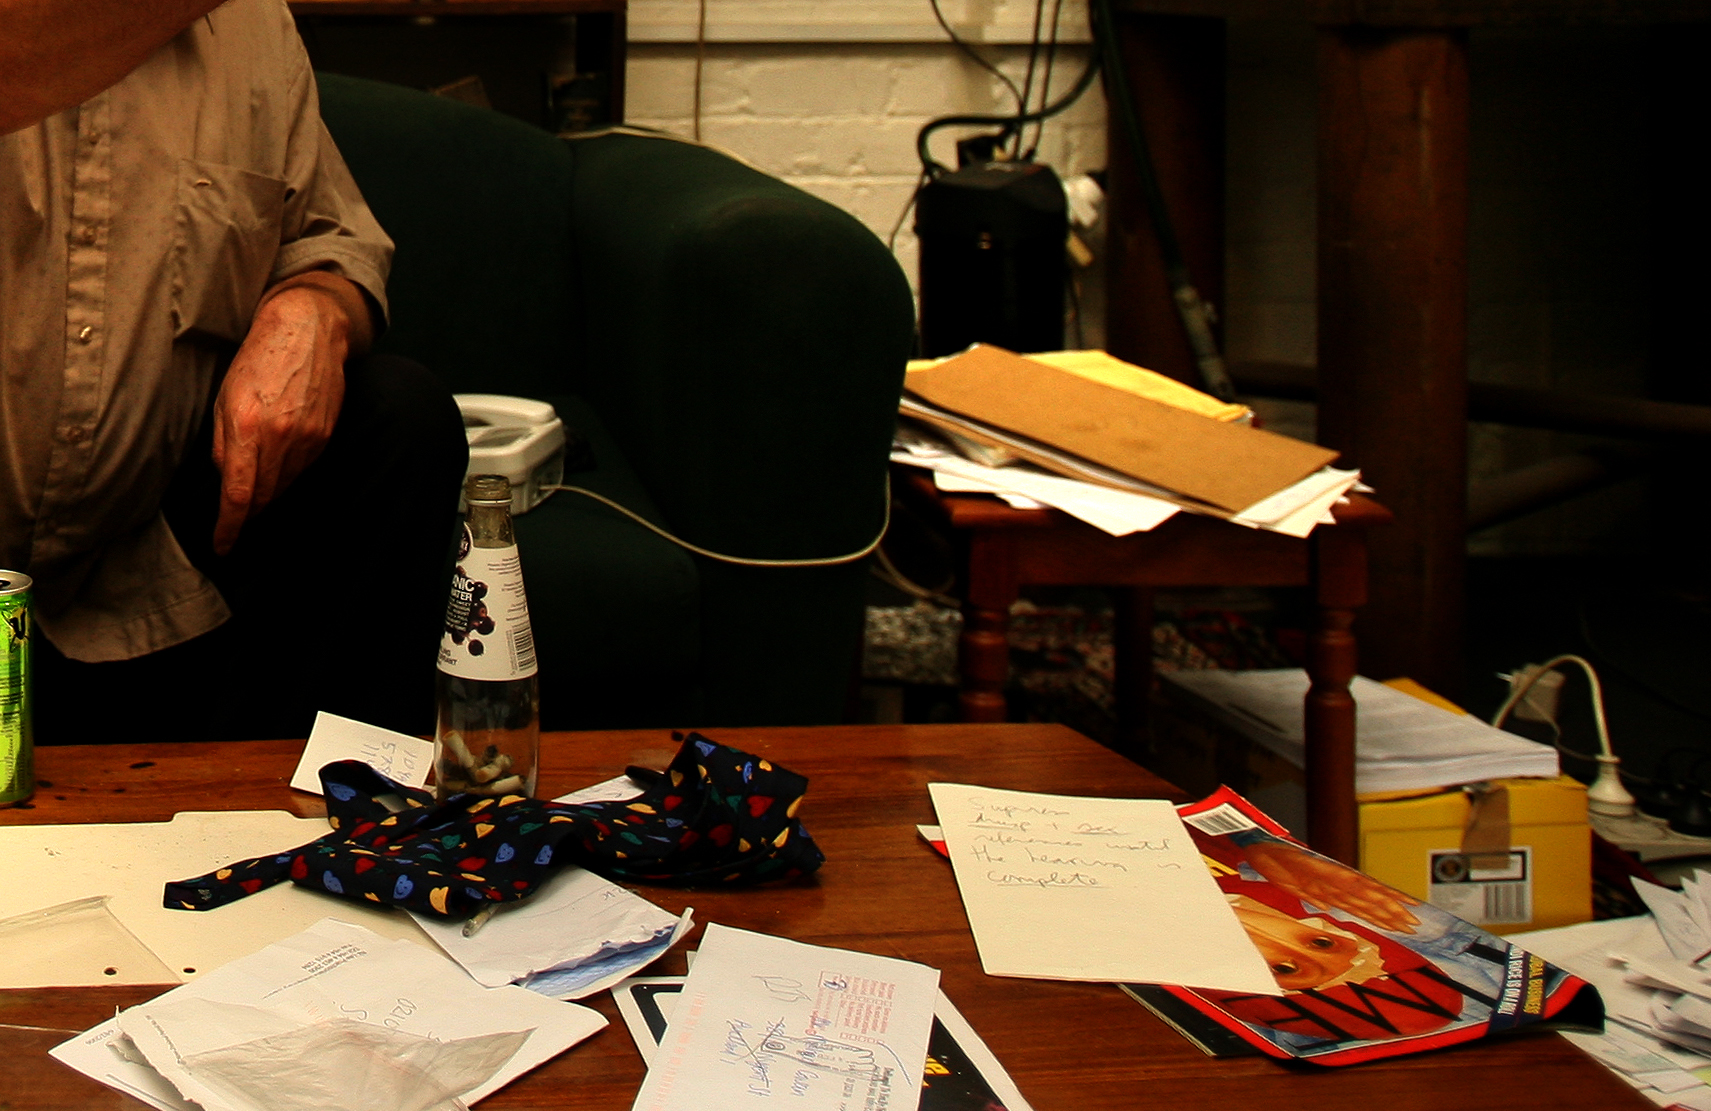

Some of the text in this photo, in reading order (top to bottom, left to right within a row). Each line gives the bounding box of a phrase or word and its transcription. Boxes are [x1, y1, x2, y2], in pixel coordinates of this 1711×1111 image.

[970, 845, 1006, 863] the
[987, 871, 1099, 888] complete
[1507, 959, 1524, 979] RICE
[1506, 979, 1523, 988] IS
[1523, 978, 1544, 1015] BUSINESS
